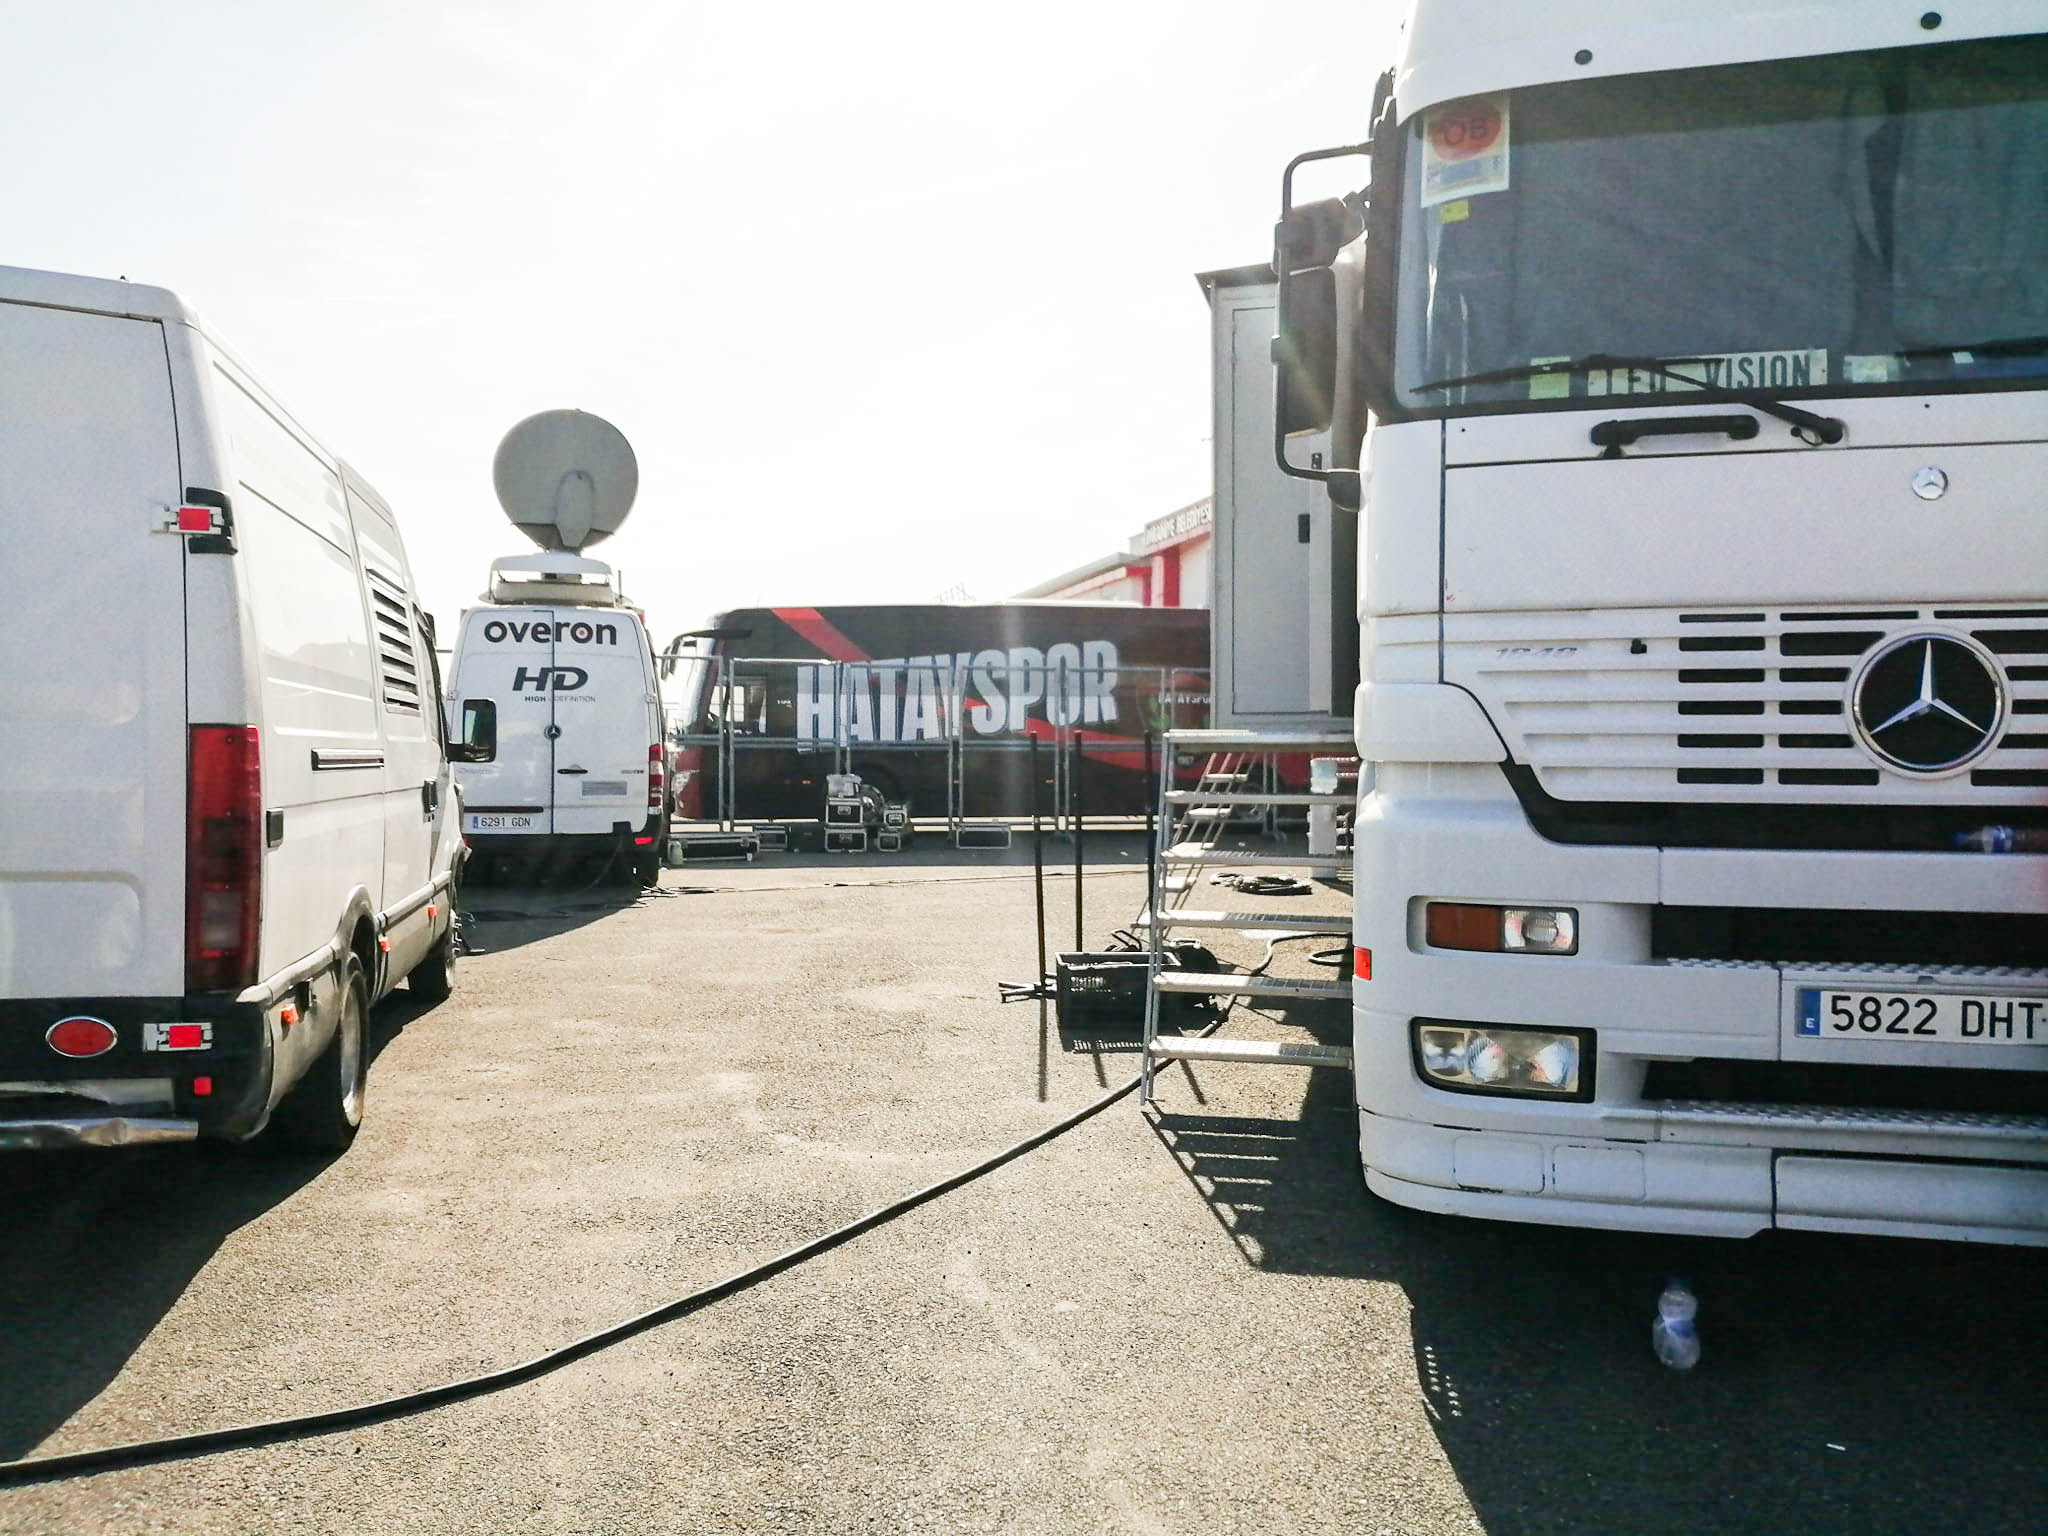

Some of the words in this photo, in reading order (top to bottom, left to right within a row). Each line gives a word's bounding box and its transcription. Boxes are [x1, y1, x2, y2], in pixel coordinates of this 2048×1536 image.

[1703, 355, 1810, 391] VISION
[483, 620, 618, 646] overon
[512, 666, 589, 692] HD
[524, 695, 546, 703] HIGH
[554, 695, 597, 703] DEFINITION
[796, 640, 1117, 752] HATAYSPOR
[481, 817, 506, 828] 6291
[511, 817, 531, 828] GDN
[1804, 1016, 1816, 1029] E
[1830, 994, 1938, 1036] 5822
[1960, 999, 2043, 1040] DHT
